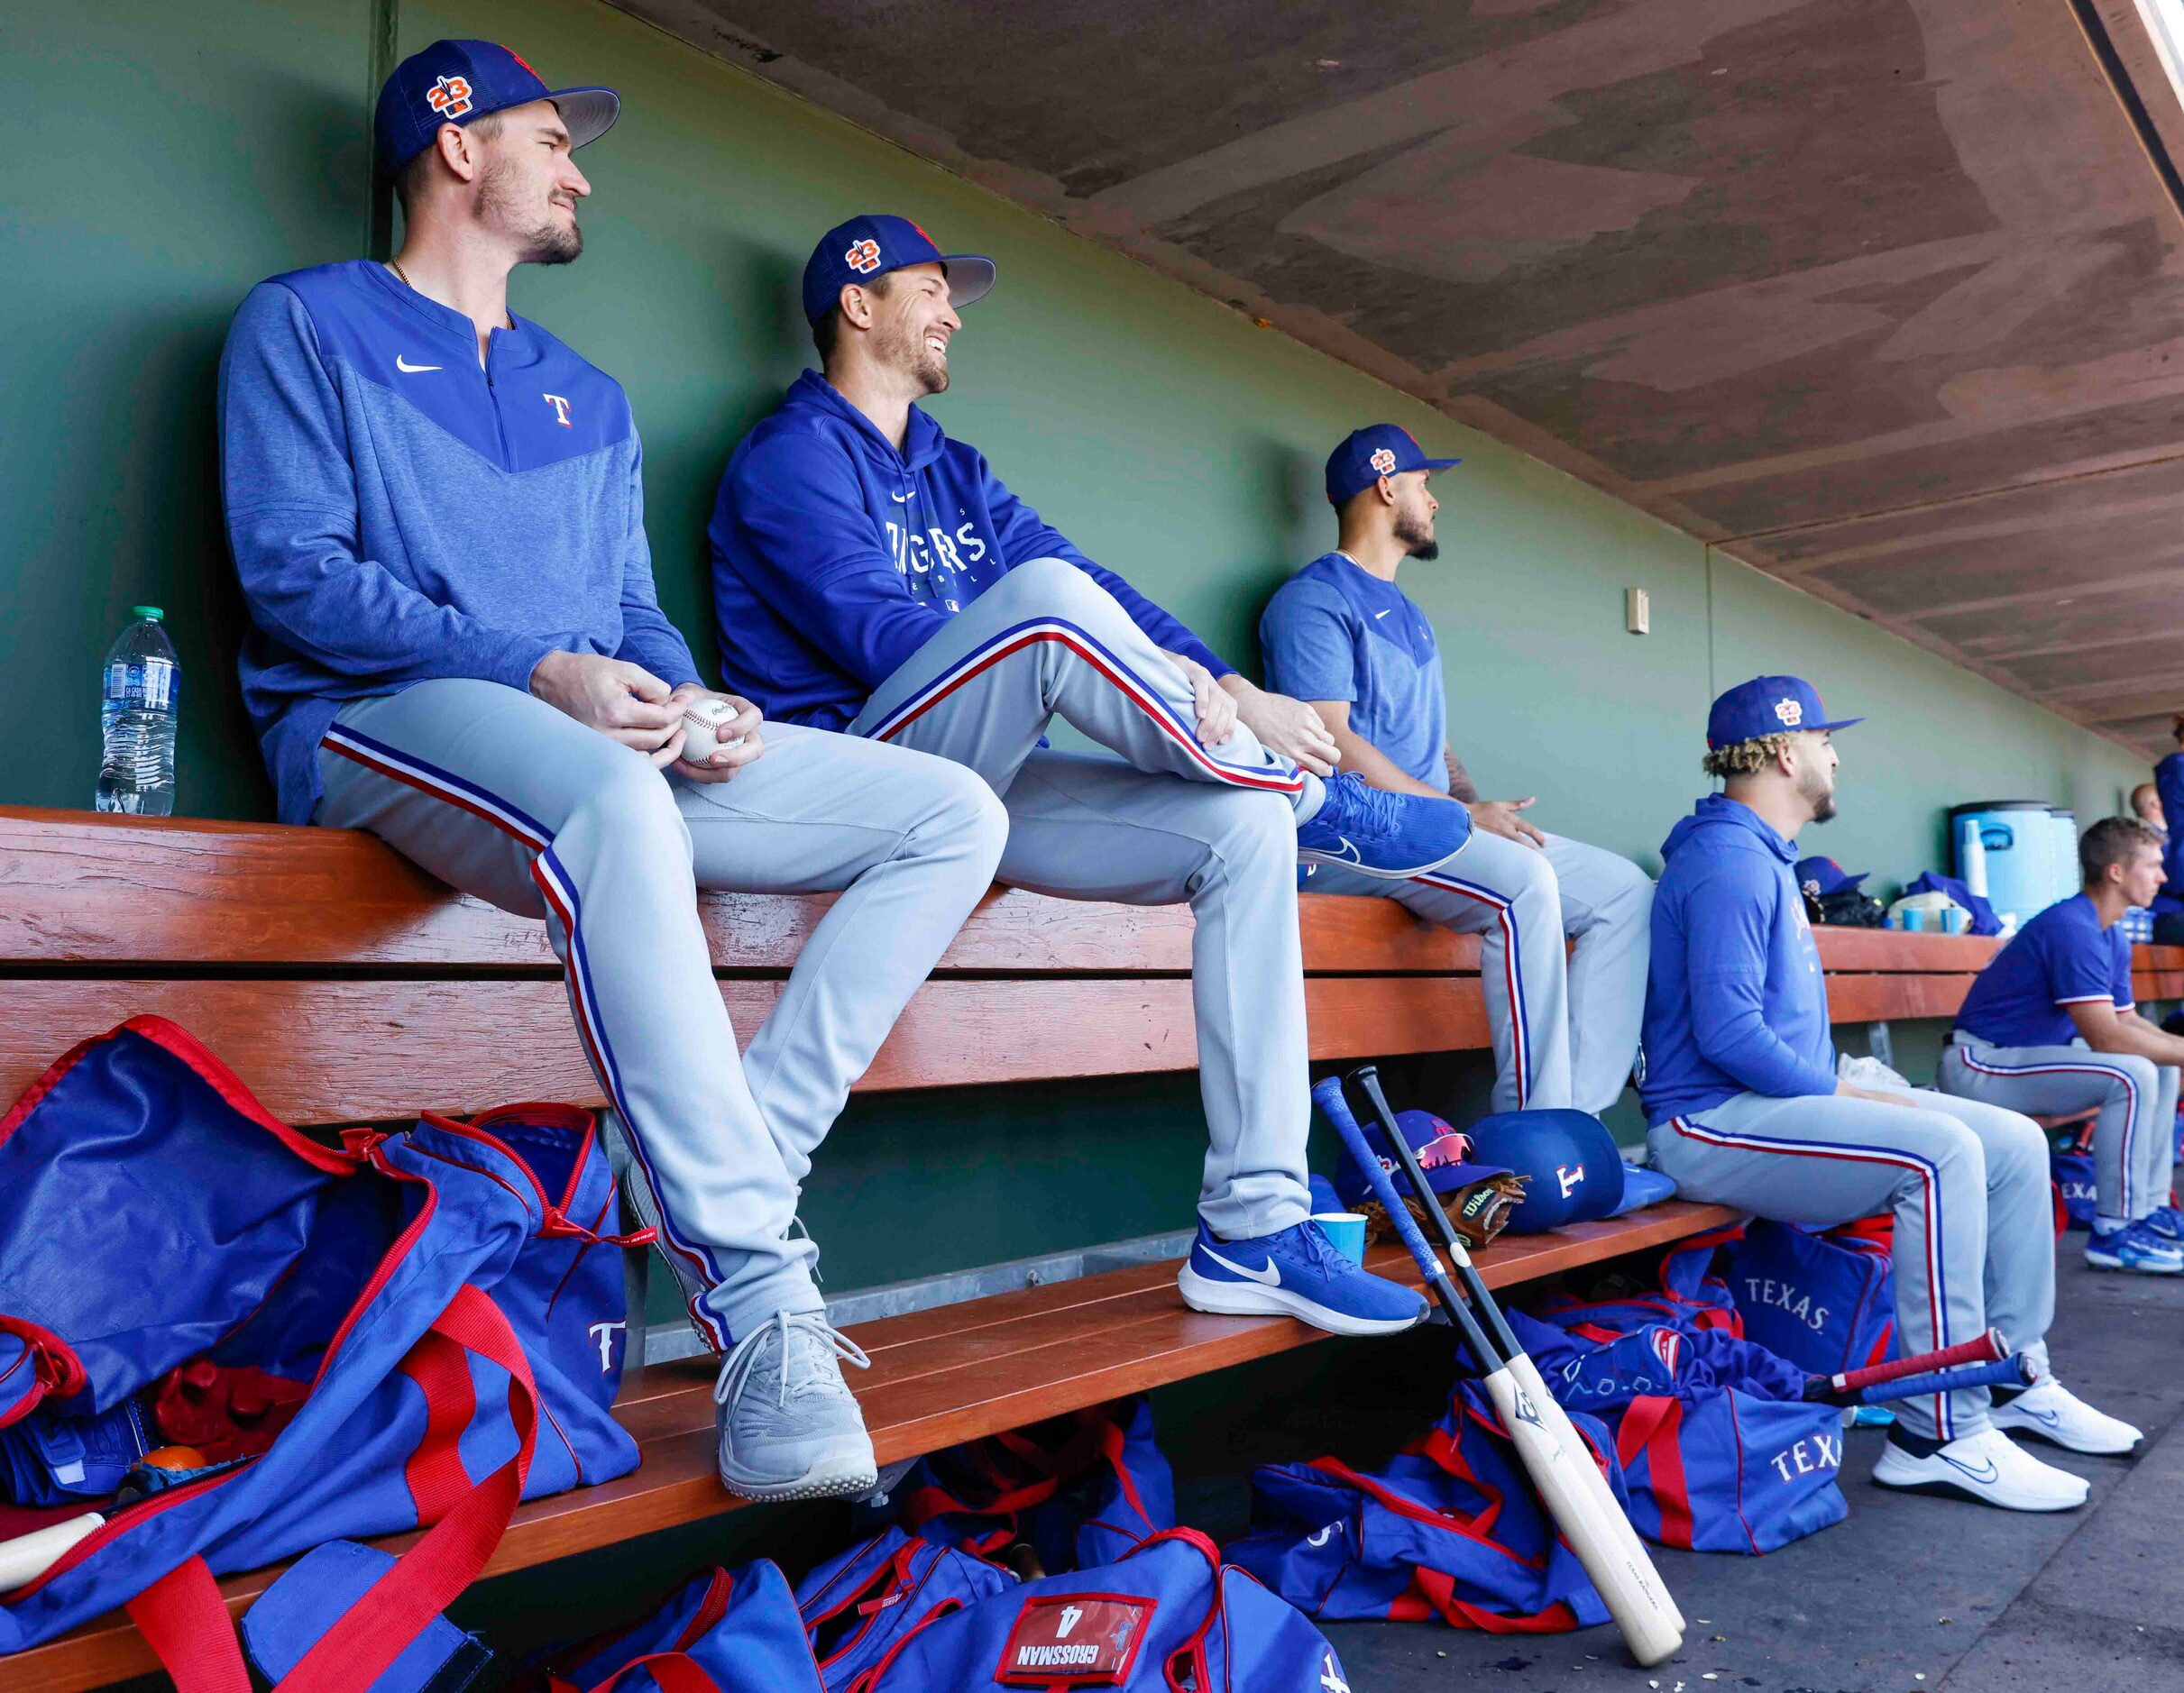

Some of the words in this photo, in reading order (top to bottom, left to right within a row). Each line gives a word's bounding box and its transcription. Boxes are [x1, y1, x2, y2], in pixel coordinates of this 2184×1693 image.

[427, 78, 469, 109] 23
[847, 241, 878, 267] 23
[542, 393, 573, 429] T
[1555, 1165, 1585, 1199] T
[1463, 1187, 1495, 1216] Wilson
[1745, 1278, 1829, 1330] TEXAS
[1056, 1606, 1083, 1638] 4
[1017, 1645, 1099, 1666] GROSSMAN
